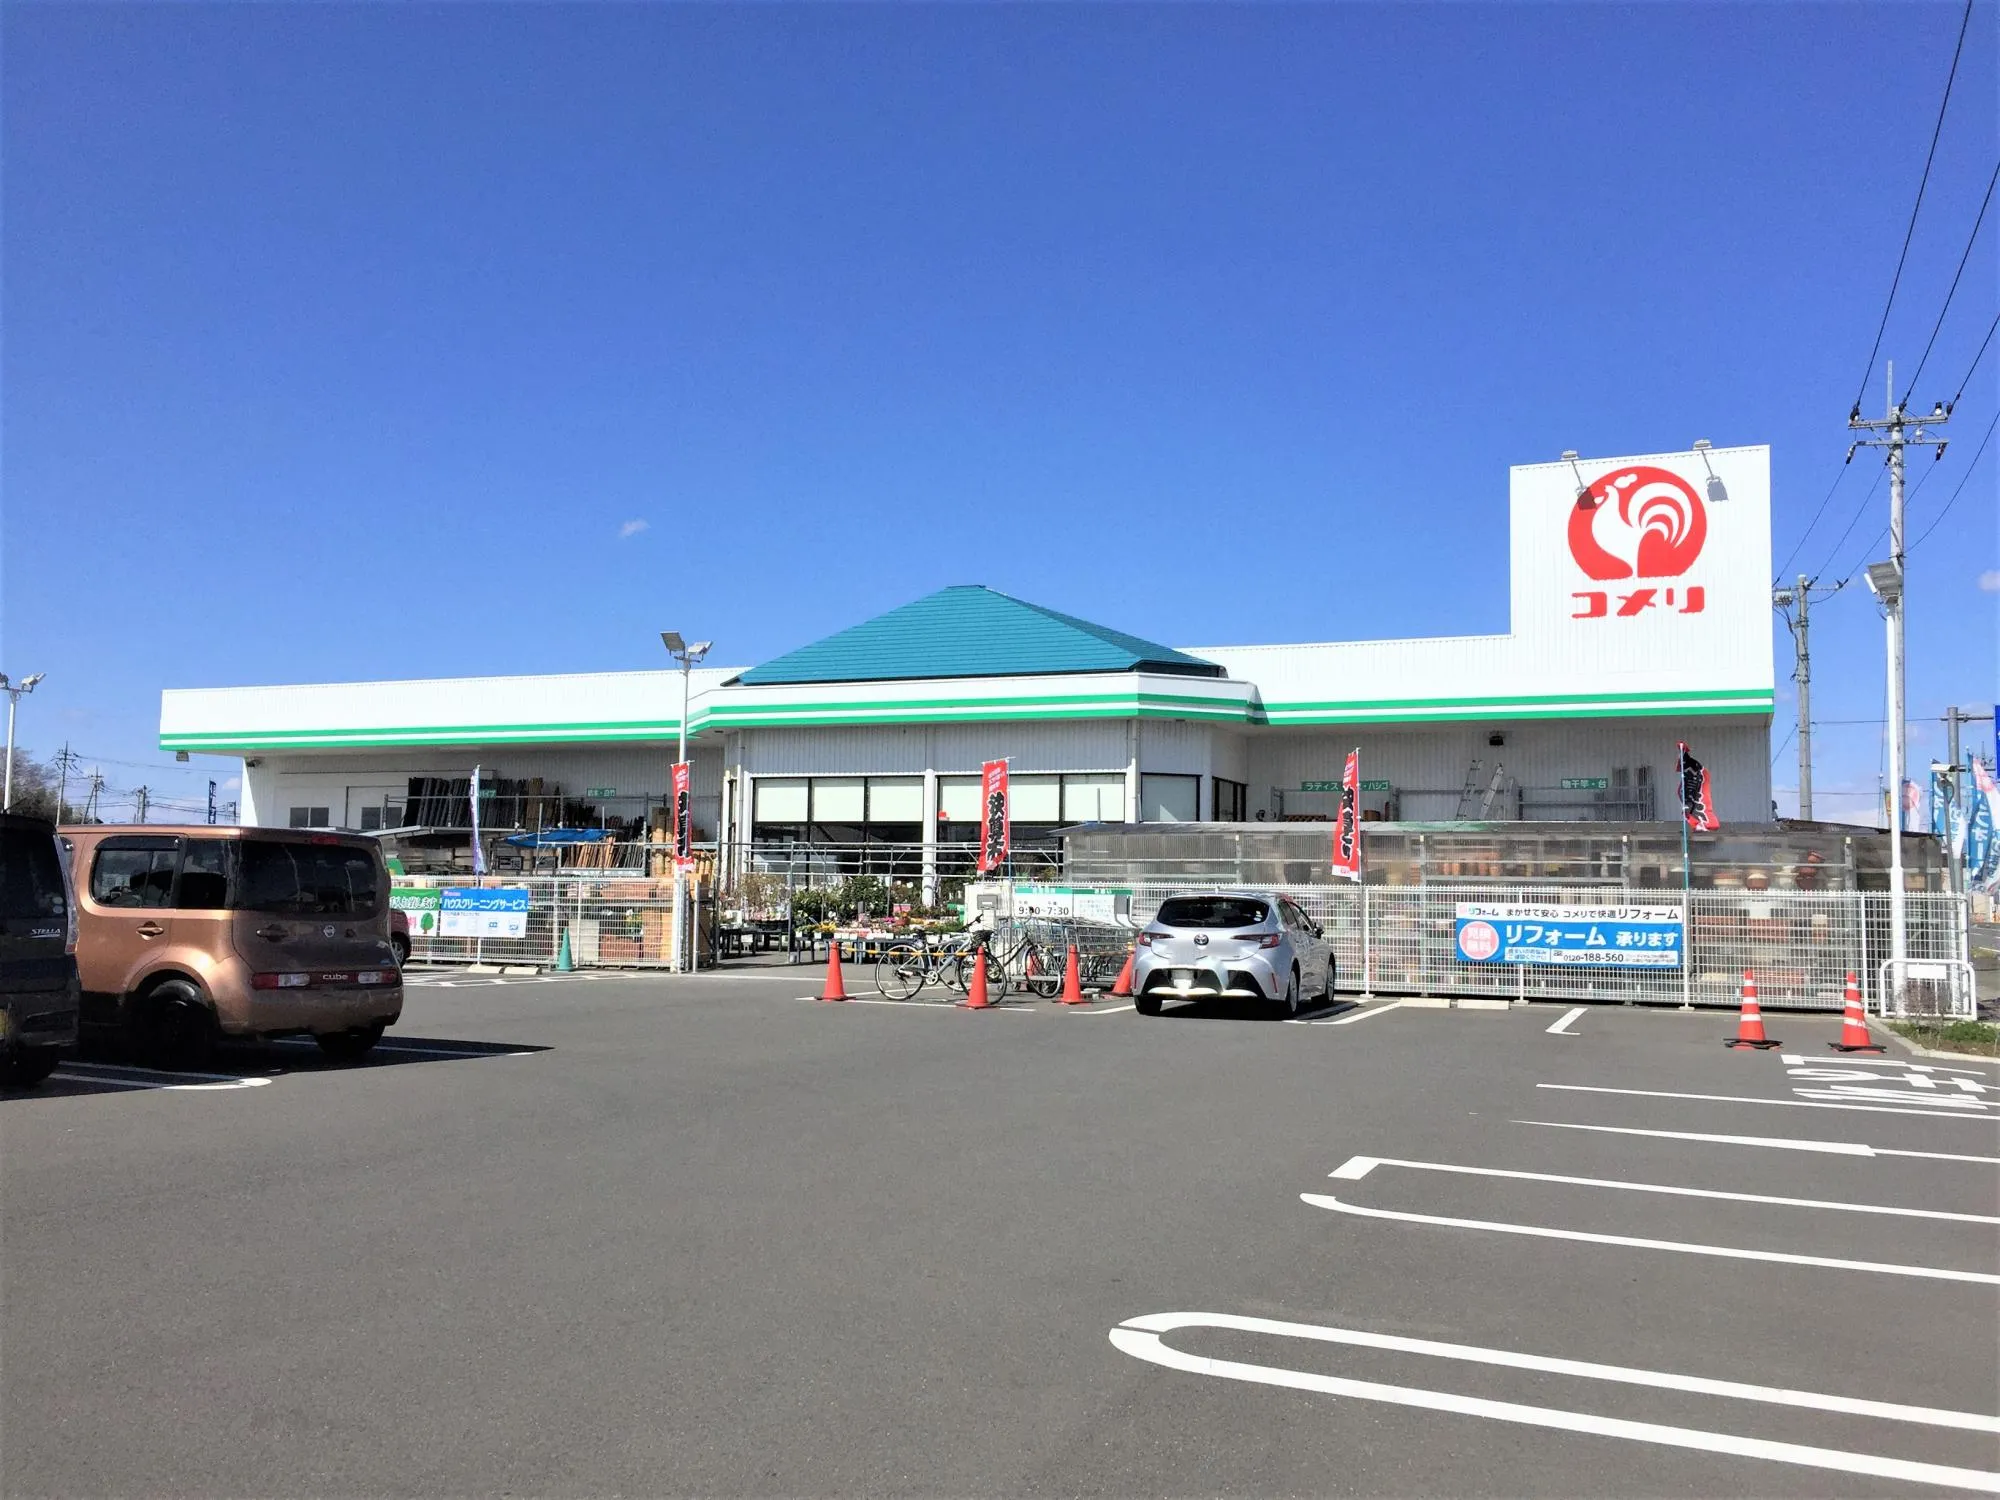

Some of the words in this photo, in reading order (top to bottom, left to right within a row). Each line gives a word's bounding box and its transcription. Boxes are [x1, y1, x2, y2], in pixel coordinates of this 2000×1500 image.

[1571, 586, 1705, 618] コメリ
[443, 899, 528, 910] ハウスクリーニングサービス
[1506, 908, 1559, 919] まかせて安心
[1506, 924, 1607, 946] リフォーム
[1615, 931, 1679, 947] 承ります
[1563, 952, 1624, 963] 0120-188-560
[322, 973, 349, 981] cube
